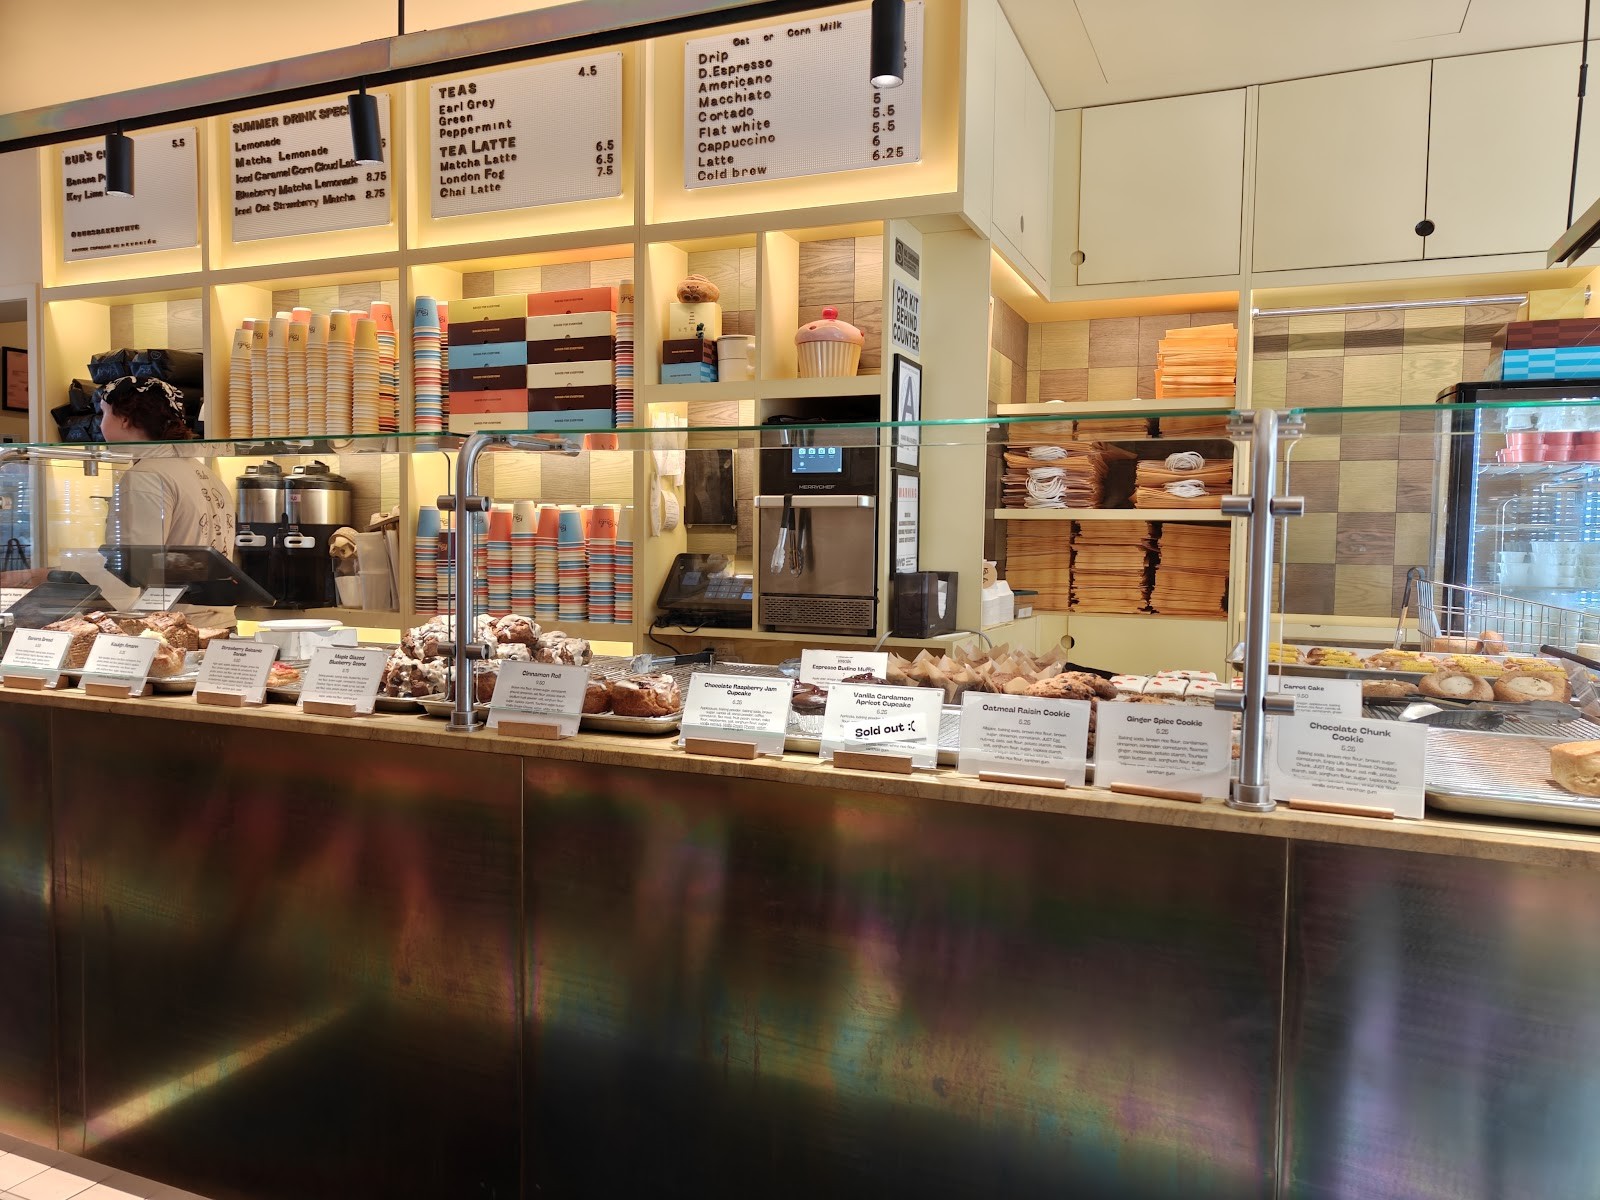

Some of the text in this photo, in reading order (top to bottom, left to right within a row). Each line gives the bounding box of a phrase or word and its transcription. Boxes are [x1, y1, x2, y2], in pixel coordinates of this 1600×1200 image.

[733, 20, 842, 46] Oat or Corn Milk
[699, 51, 728, 64] Drip
[699, 59, 772, 78] D.Espresso
[439, 65, 598, 98] TEAS 4.5
[698, 74, 772, 93] Americano
[439, 98, 495, 114] Earl Grey
[700, 88, 881, 108] Macchiato 5
[232, 105, 350, 134] SUMMER DRINK SPECI
[439, 114, 473, 126] Green
[698, 105, 895, 122] Cortado 5.5
[440, 119, 512, 138] Peppermint
[700, 118, 895, 138] Flat white 5.5
[65, 150, 92, 165] BUB'S
[172, 138, 185, 148] 5.5
[235, 137, 281, 152] Lemonade
[440, 136, 516, 158] TEA LATTE
[698, 133, 880, 154] Cappuccino 6
[236, 146, 328, 168] Matcha Lemonade
[440, 140, 614, 171] Matcha Latte 6.5
[699, 147, 904, 167] Latte 6.25
[236, 174, 253, 184] Iced
[254, 168, 290, 181] Caramel
[292, 166, 314, 176] Corn
[315, 160, 338, 172] Cloud
[440, 153, 614, 184] London Fog 6.5
[698, 166, 767, 182] Cold brew
[66, 177, 96, 186] Banana
[236, 172, 386, 200] Blueberry Matcha Lemonade 8.75
[440, 165, 613, 198] Chai Latte 7.5
[66, 192, 82, 202] Key
[84, 190, 104, 199] Lime
[235, 189, 385, 216] Iced Oat Strawberry Matcha 8.75
[896, 286, 919, 314] CPR KIT
[896, 305, 918, 332] BEHIND
[894, 323, 919, 351] COUNTER
[902, 375, 915, 422] A
[877, 693, 914, 702] Cardamom
[882, 700, 911, 708] Cupcake
[982, 704, 1070, 717] Oatmeal Raisin Cookie
[855, 726, 881, 738] Sold
[884, 723, 905, 734] out
[1310, 722, 1392, 737] Chocolate Chunk
[1332, 733, 1364, 743] Cookie
